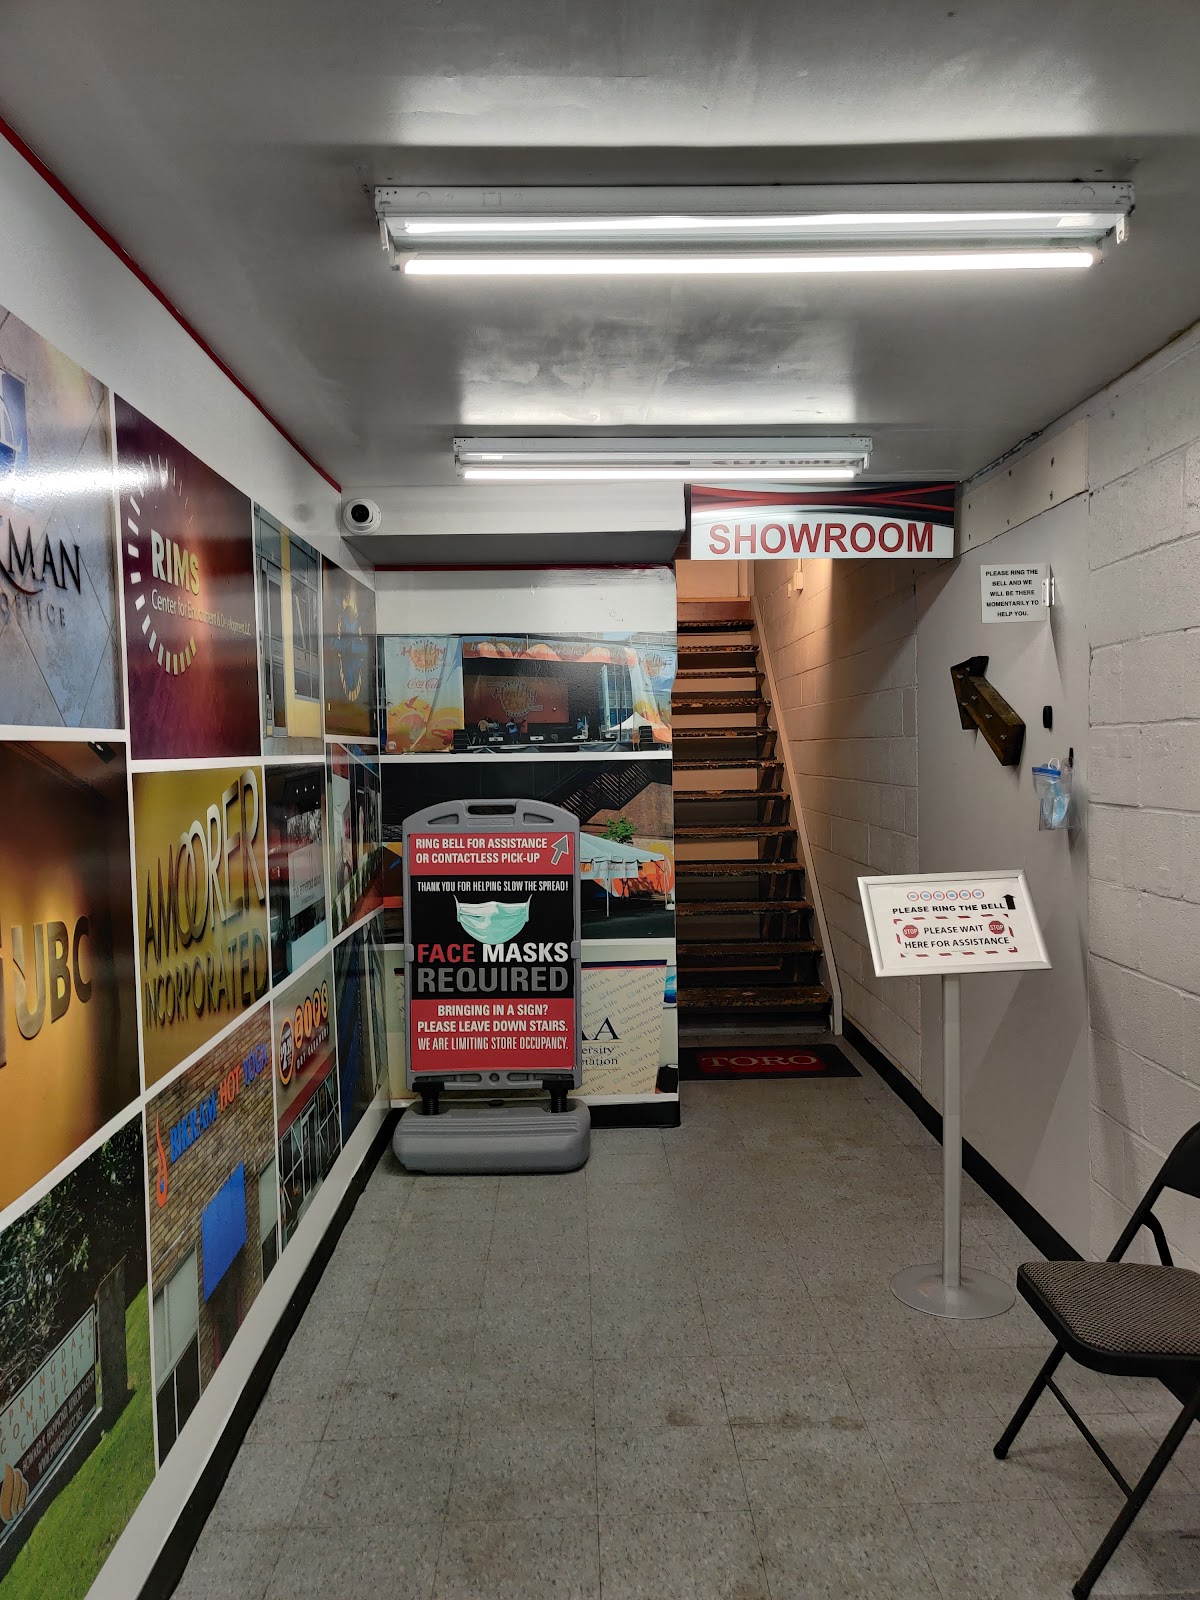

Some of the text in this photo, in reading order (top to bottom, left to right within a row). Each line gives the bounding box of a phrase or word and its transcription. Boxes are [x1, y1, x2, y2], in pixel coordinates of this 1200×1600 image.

[709, 522, 933, 554] SHOWROOM
[1, 516, 81, 595] MAN
[151, 528, 200, 595] RIMS
[151, 589, 176, 615] Center
[177, 597, 187, 617] for
[415, 838, 548, 849] RING BELL FOR ASSISTANCE
[415, 852, 540, 864] OR CONTACTLESS PICK-UP
[144, 769, 266, 971] AMOORER
[417, 880, 569, 892] THANK YOU FOR HELPING SLOW THE SPREAD!
[892, 905, 930, 914] PLEASE
[924, 926, 958, 934] PLEASE
[960, 924, 984, 932] WAIT
[417, 942, 569, 963] FACE MASKS
[904, 937, 1010, 949] HERE FOR ASSISTANCE
[7, 915, 92, 1042] UBC
[145, 927, 269, 1030] INCORPORATED
[417, 967, 569, 993] REQUIRED
[437, 1004, 549, 1016] BRINGING IN A SIGN?
[627, 1001, 663, 1022] howard.ed
[417, 1020, 569, 1033] PLEASE LEAVE DOWN STAIRS.
[417, 1036, 569, 1050] WE ARE LIMITING STORE OCCUPANCY.
[582, 1046, 614, 1056] ersity
[701, 1055, 817, 1067] TORO
[170, 1088, 218, 1163] BIKRAM
[219, 1065, 241, 1112] HOT
[242, 1043, 268, 1087] YOGA
[0, 1335, 92, 1453] COMMUNITY
[20, 1367, 78, 1450] CHURCH
